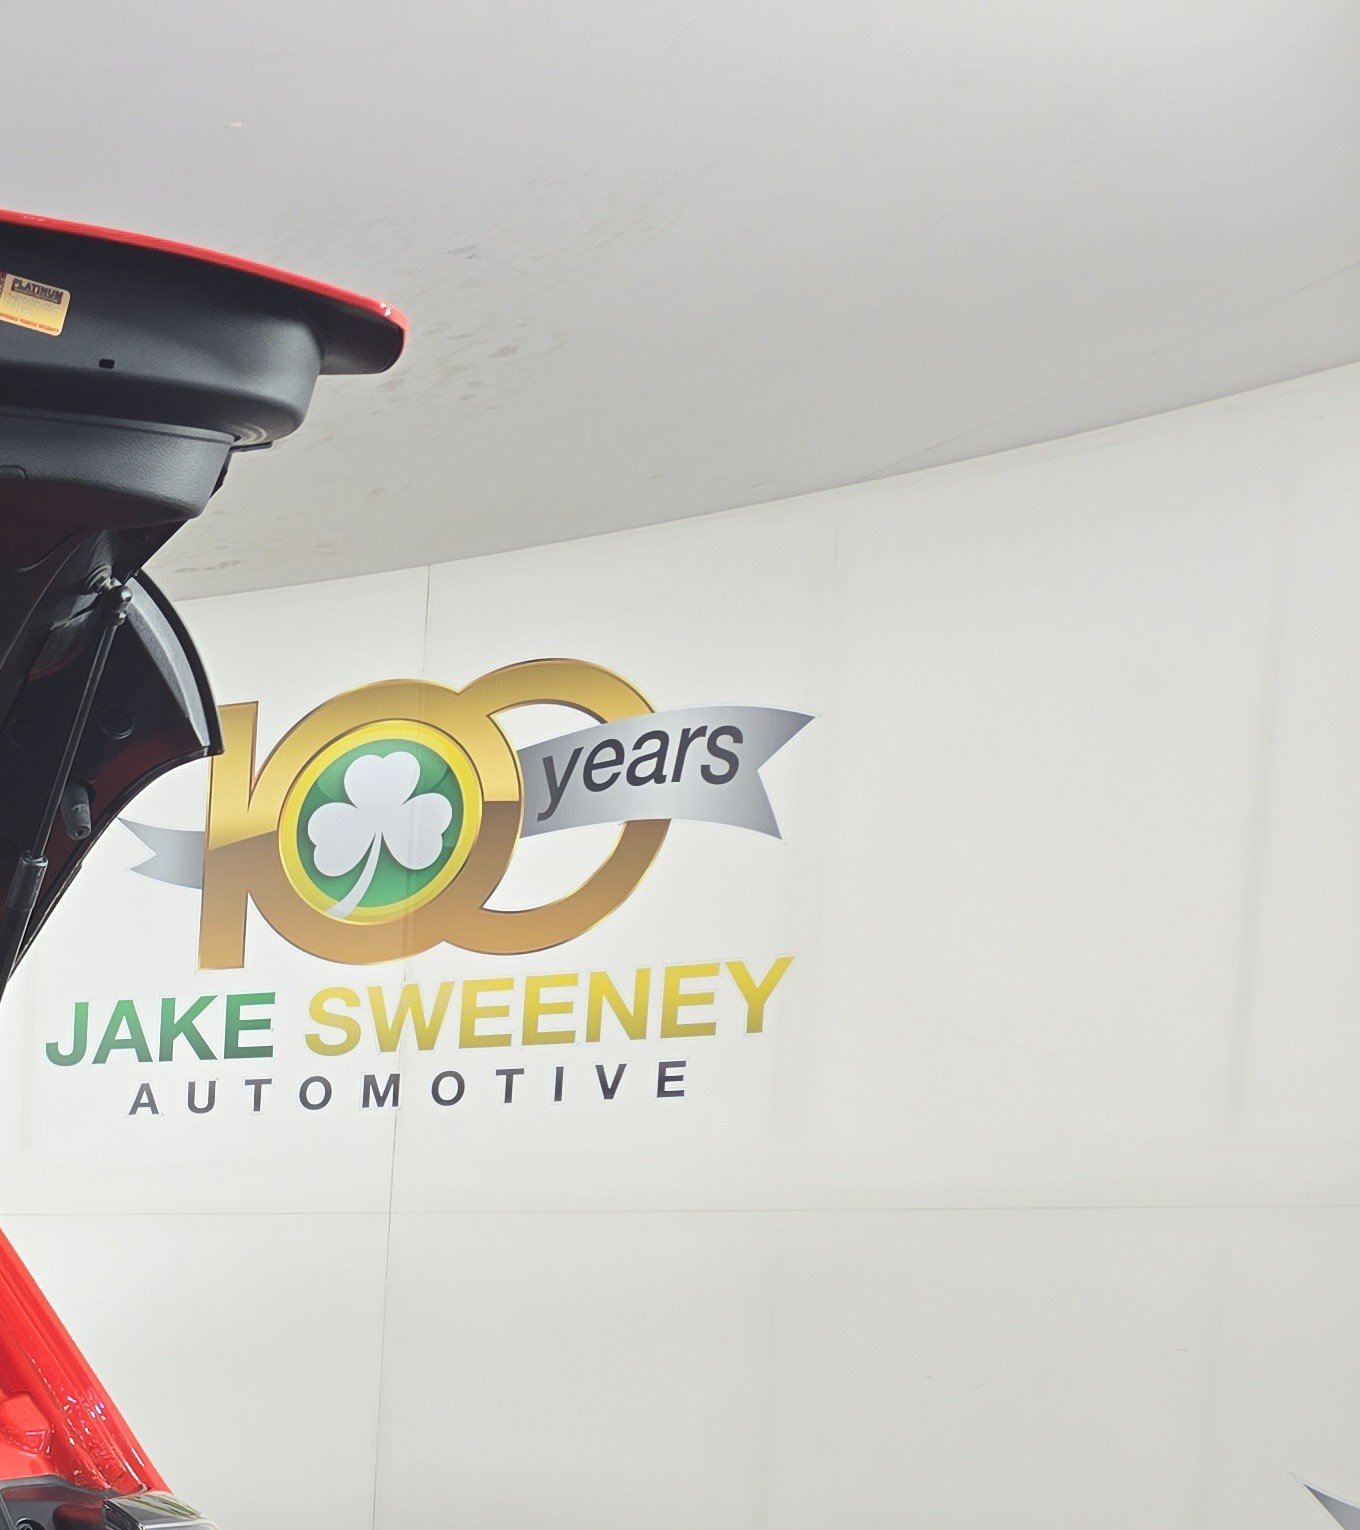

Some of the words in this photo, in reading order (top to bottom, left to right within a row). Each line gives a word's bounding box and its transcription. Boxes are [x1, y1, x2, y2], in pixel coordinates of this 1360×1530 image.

[198, 657, 674, 970] 100
[536, 723, 745, 822] years
[45, 992, 276, 1066] JAKE
[304, 956, 795, 1056] SWEENEY
[128, 1060, 688, 1116] AUTOMOTIVE
